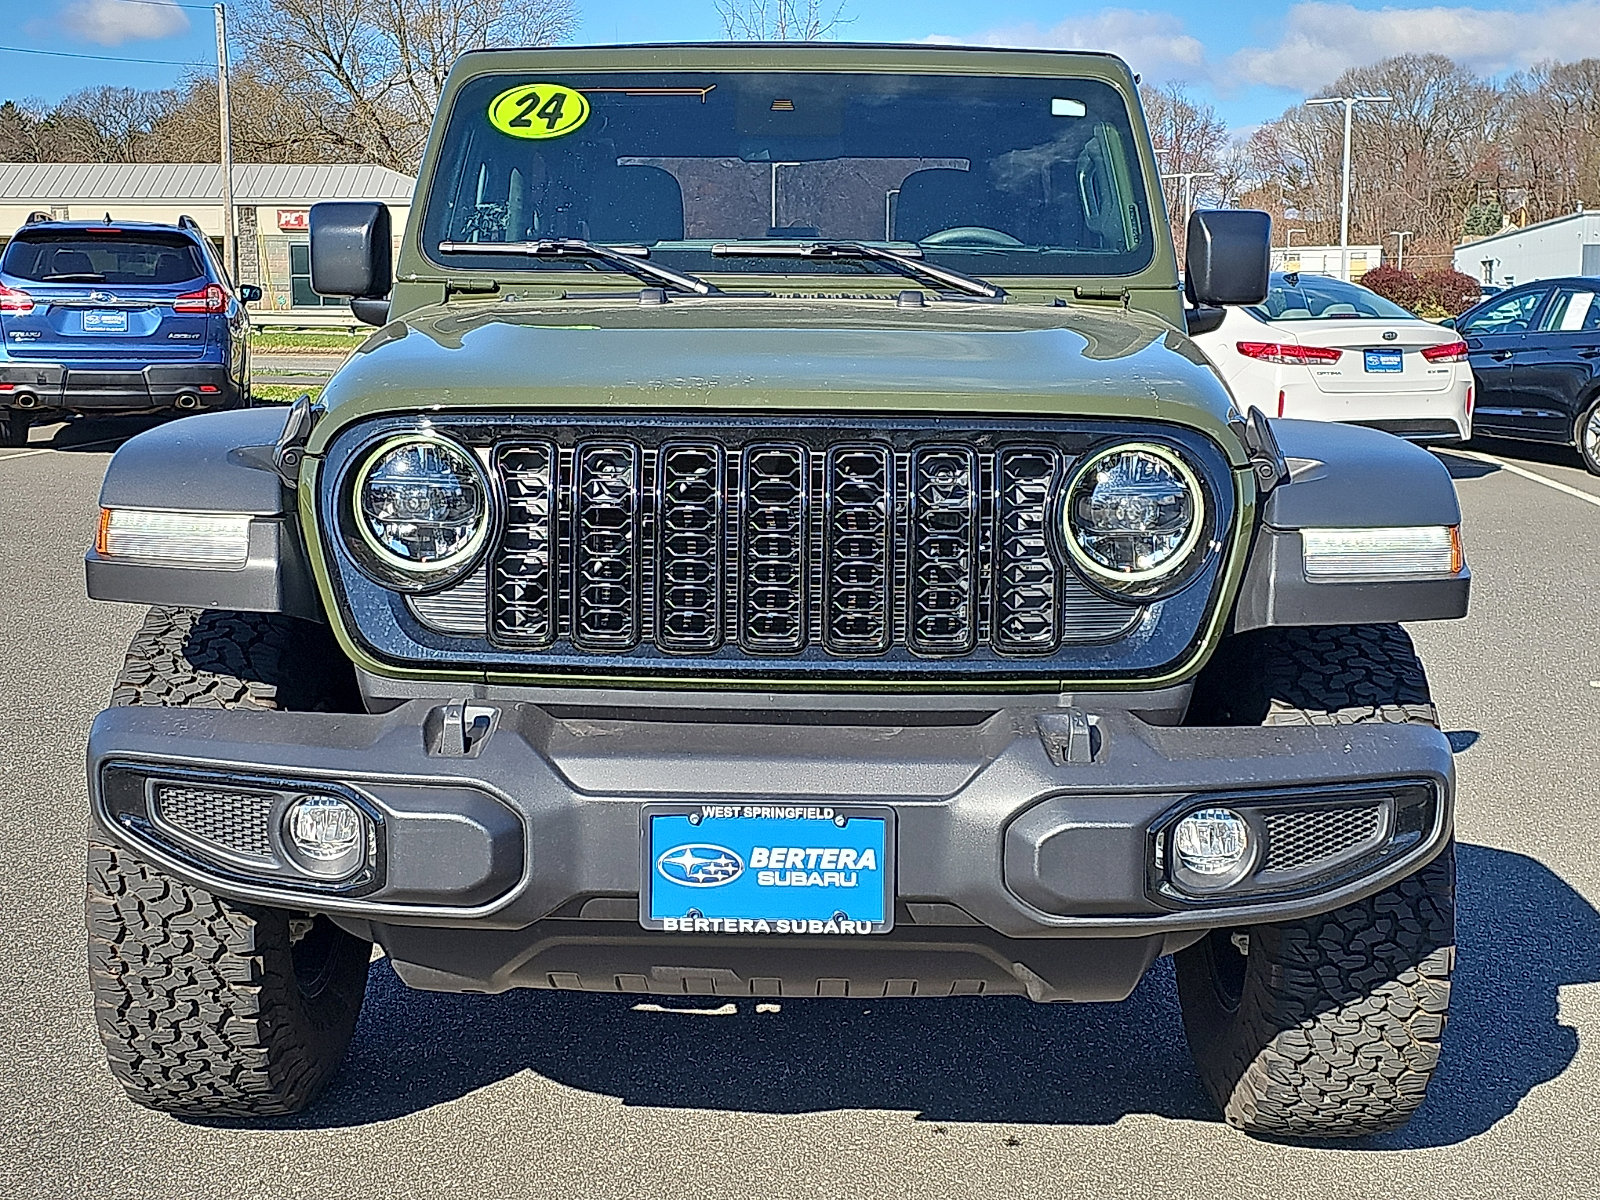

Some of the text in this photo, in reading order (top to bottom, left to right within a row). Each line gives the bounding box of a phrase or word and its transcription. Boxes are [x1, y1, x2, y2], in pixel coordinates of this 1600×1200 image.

[508, 92, 567, 129] 24
[702, 806, 835, 820] WEST SPRINGFIELD
[750, 847, 877, 870] BERTERA
[757, 871, 858, 887] SUBARU
[663, 917, 872, 935] BERTERA SUBARU
